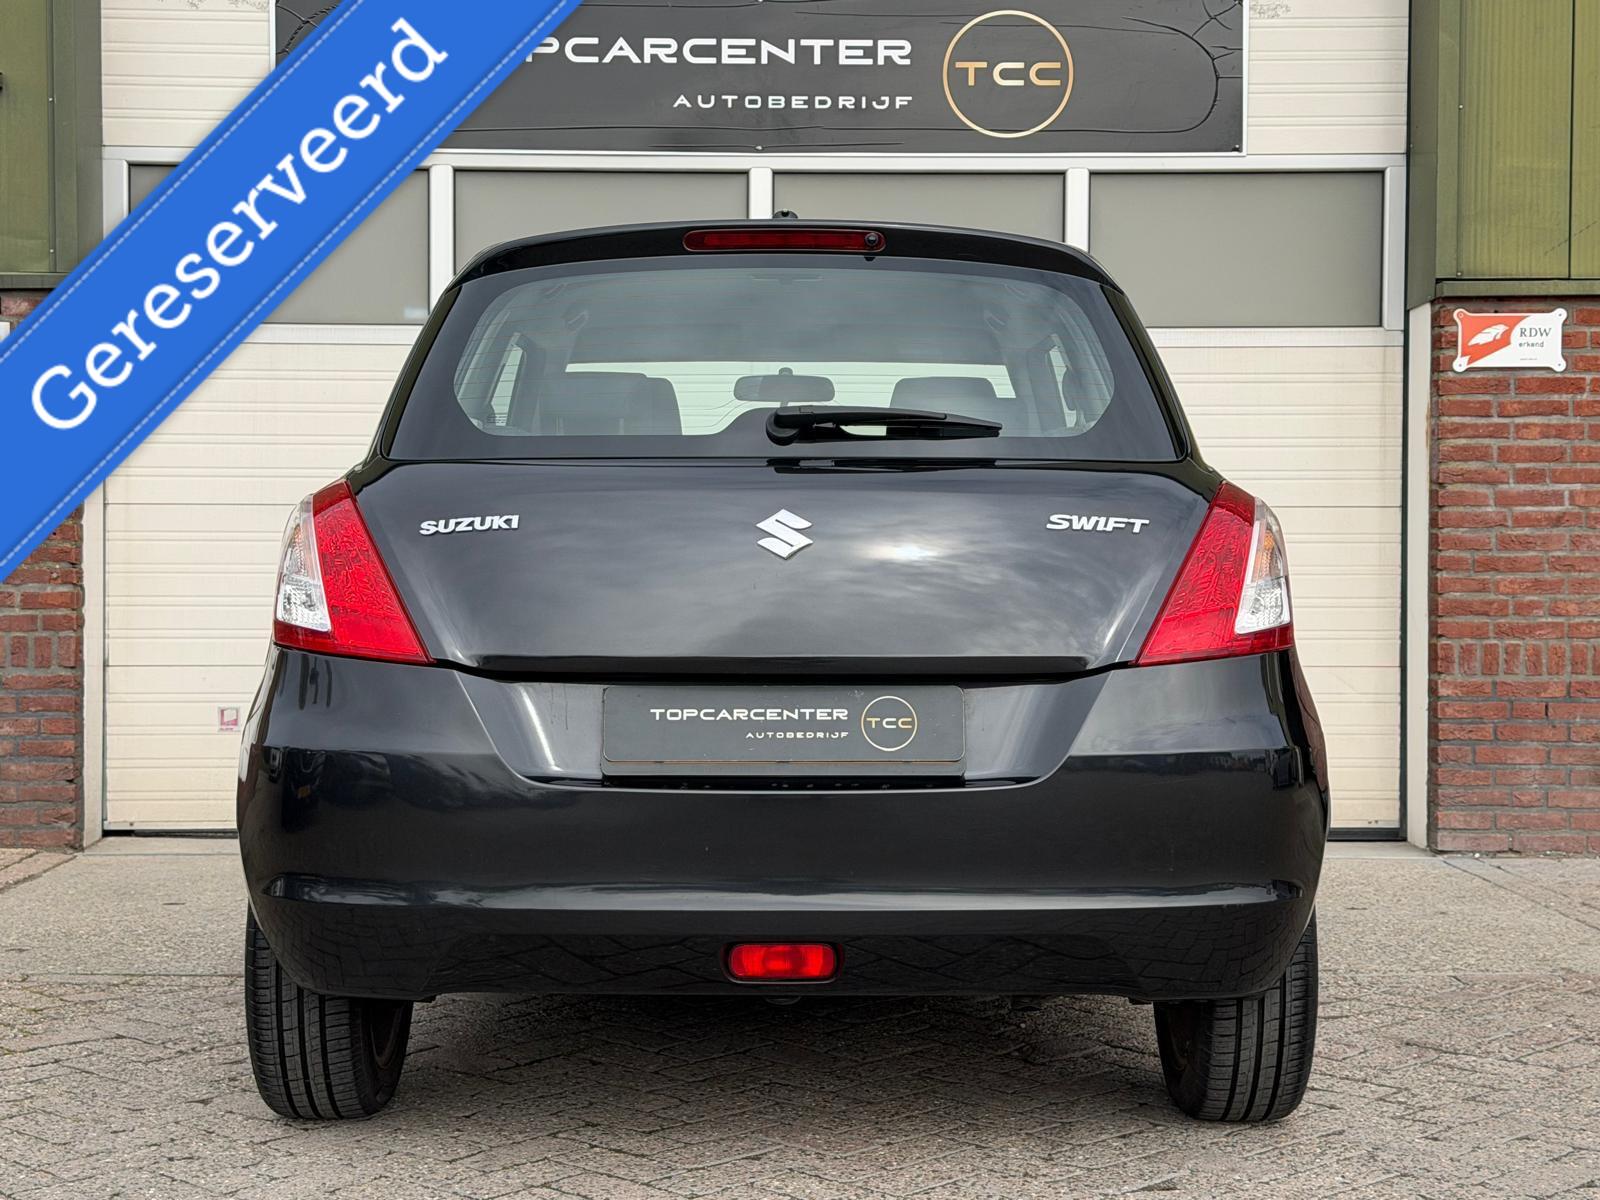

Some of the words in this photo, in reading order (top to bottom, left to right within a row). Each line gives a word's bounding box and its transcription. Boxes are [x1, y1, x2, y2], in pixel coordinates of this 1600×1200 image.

[955, 61, 1062, 86] TCC
[672, 95, 913, 110] AUTOBEDRIJF
[1519, 327, 1552, 338] RDW
[419, 514, 520, 536] SUZUKI
[1046, 513, 1150, 533] SWIFT
[649, 708, 849, 721] TOPCARCENTER
[866, 717, 913, 729] TCC
[745, 731, 849, 739] AUTOBEDRIJF
